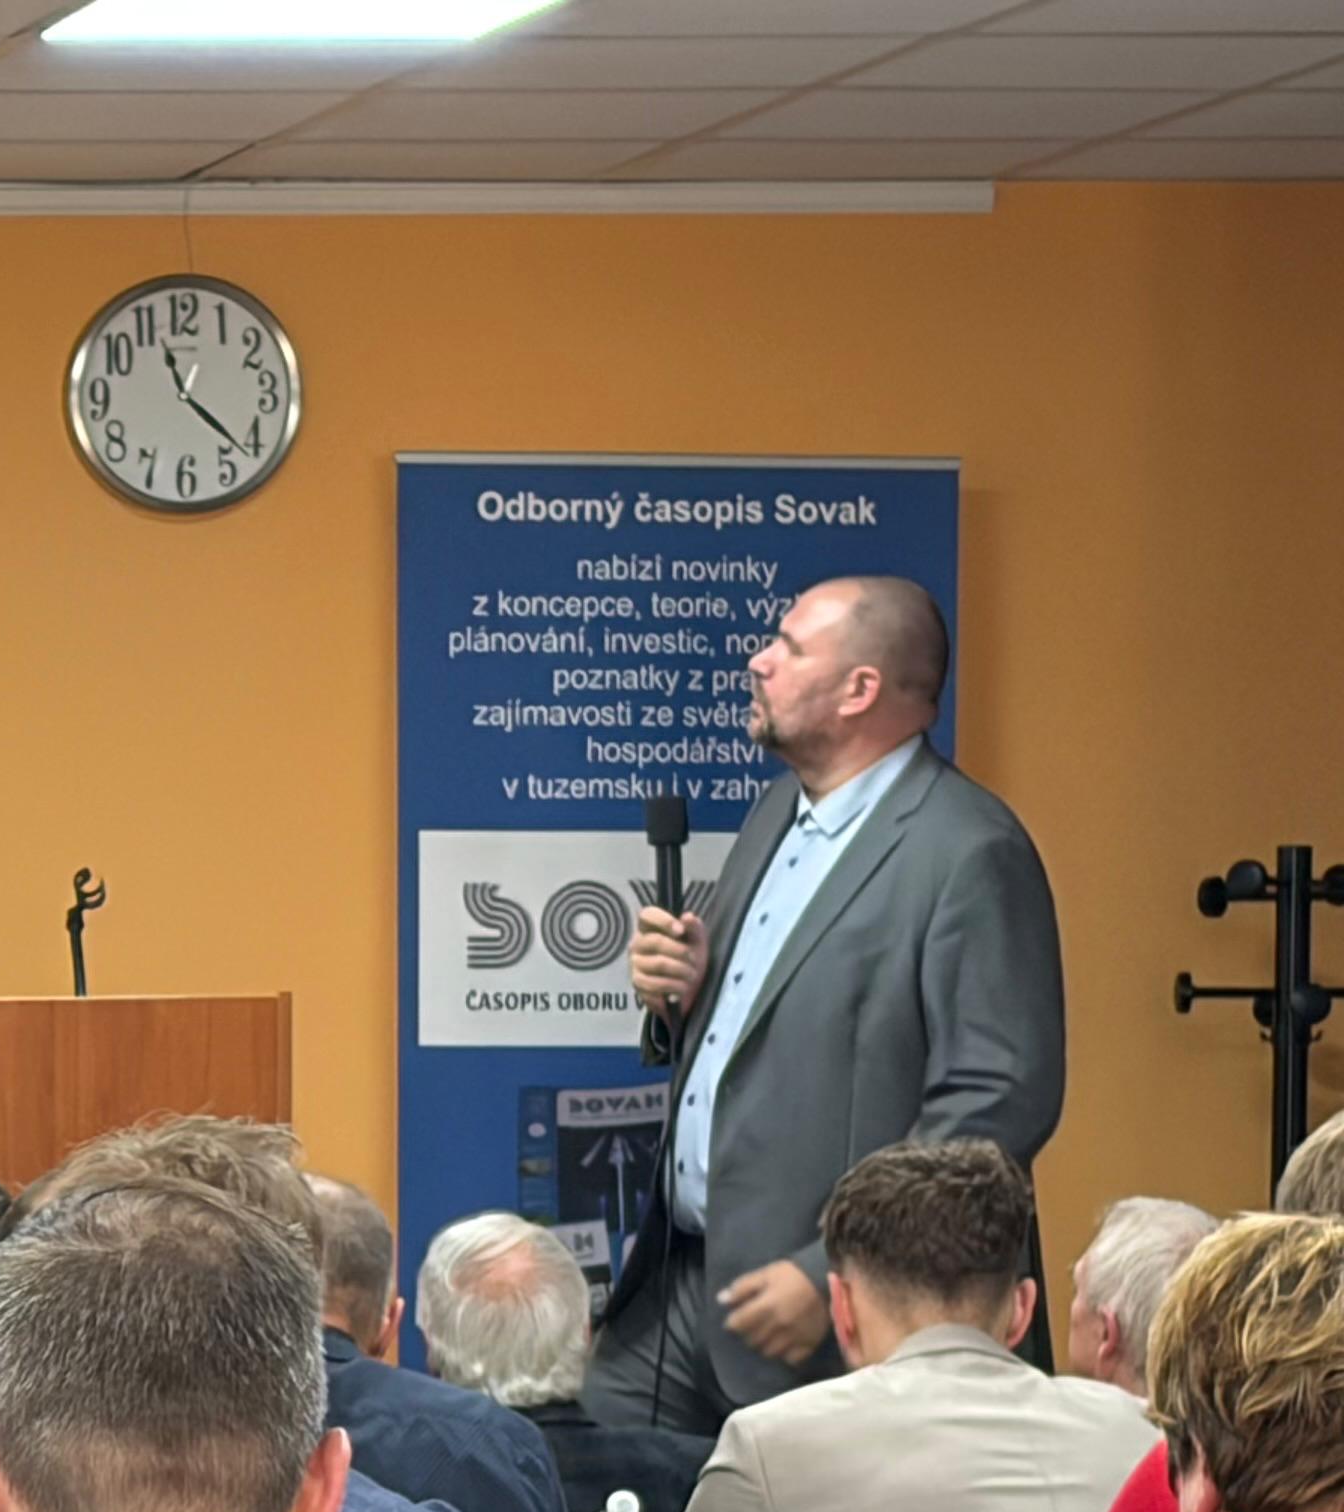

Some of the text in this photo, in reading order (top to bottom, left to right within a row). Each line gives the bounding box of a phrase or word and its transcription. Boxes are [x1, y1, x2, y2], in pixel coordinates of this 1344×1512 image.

[132, 305, 155, 346] 11
[167, 293, 199, 336] 12
[214, 303, 226, 345] 1
[104, 333, 133, 376] 10
[243, 327, 262, 370] 2
[89, 378, 111, 422] 9
[258, 370, 279, 414] 3
[104, 420, 126, 462] 8
[244, 415, 264, 458] 4
[138, 446, 157, 489] 7
[175, 454, 197, 499] 6
[217, 446, 237, 487] 5
[477, 490, 877, 530] Odborný časopis Sovak
[671, 555, 778, 589] novinky
[472, 597, 489, 617] z
[498, 590, 642, 622] koncepce,
[651, 592, 736, 622] teorie,
[448, 624, 593, 658] plánování,
[603, 627, 716, 656] investic,
[552, 665, 753, 698] poznatky z pra
[472, 699, 632, 734] zajímavosti
[641, 707, 674, 728] ze
[501, 779, 519, 800] v
[527, 770, 664, 800] tuzemsku
[687, 779, 703, 800] v
[465, 988, 552, 1012] ČASOPIS
[557, 992, 629, 1011] OBORU
